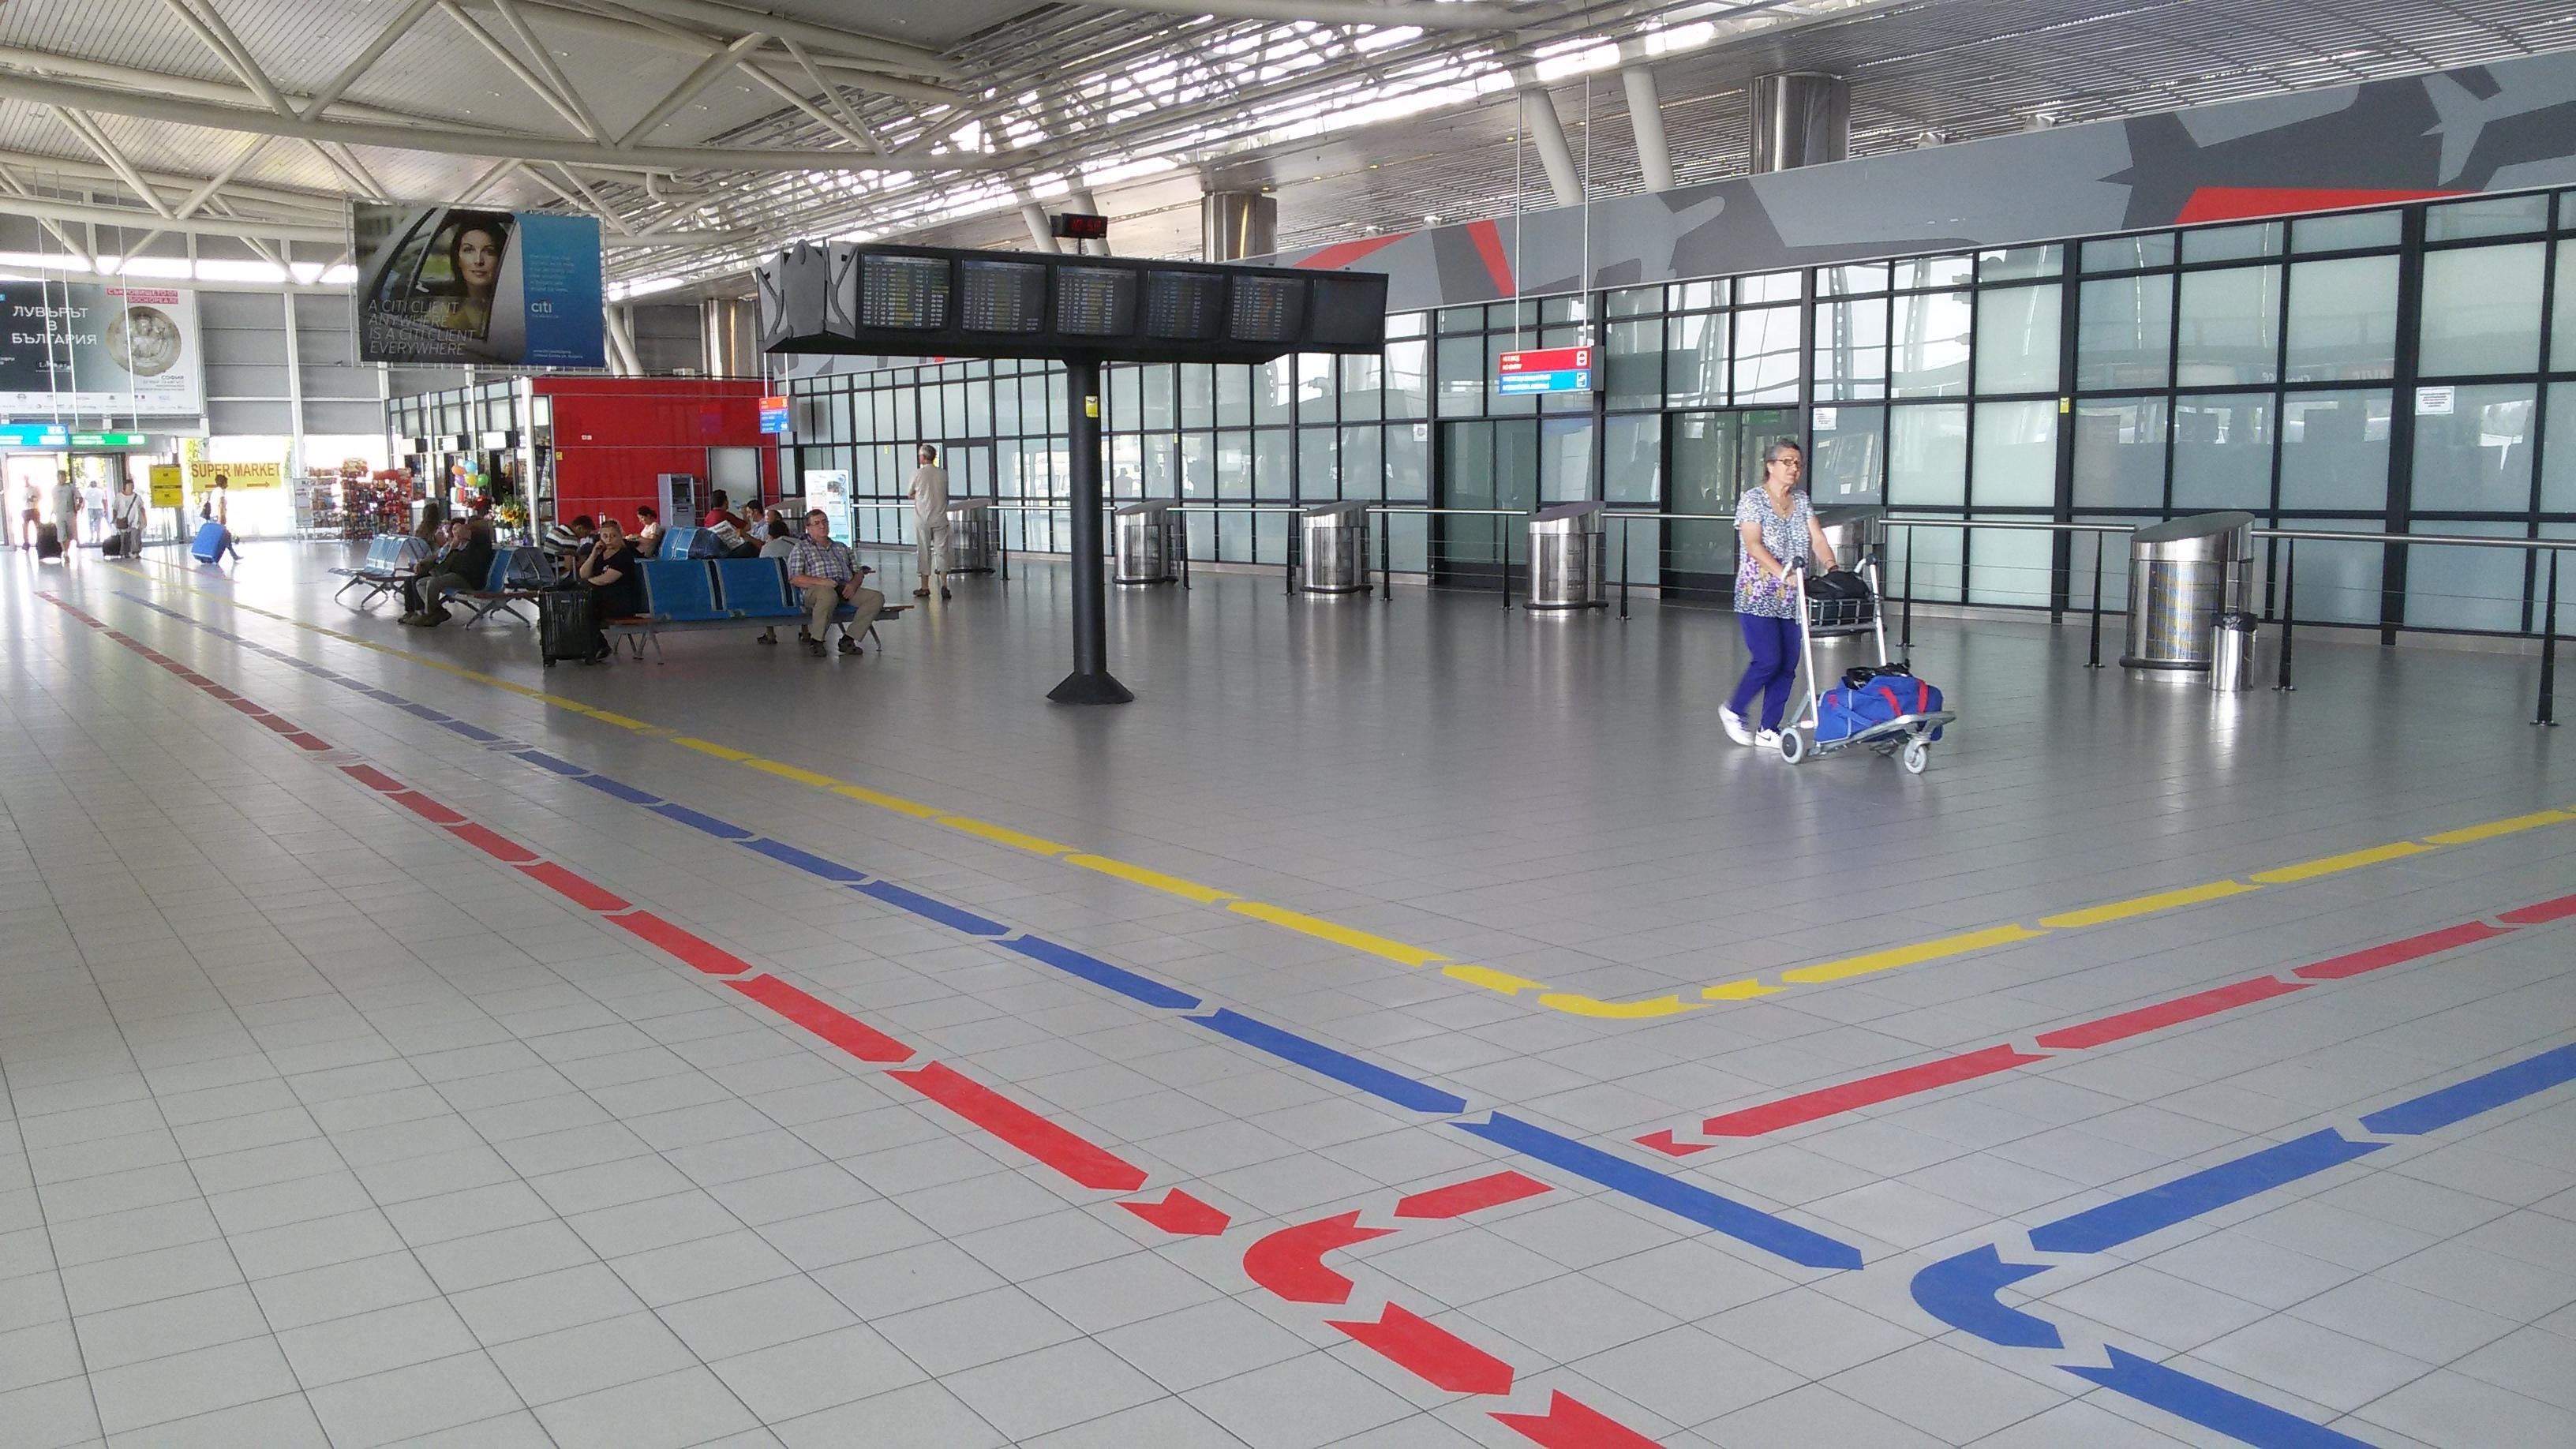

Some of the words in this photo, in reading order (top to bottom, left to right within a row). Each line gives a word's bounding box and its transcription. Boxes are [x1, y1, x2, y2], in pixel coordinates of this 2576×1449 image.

[368, 299, 378, 312] A
[381, 299, 406, 313] CITI
[411, 300, 459, 314] CLIENT
[531, 301, 552, 313] citi
[368, 313, 449, 328] ANYWHERE
[369, 328, 381, 340] IS
[386, 328, 395, 340] A
[399, 328, 424, 341] CITI
[428, 329, 477, 343] CLIENT
[370, 341, 467, 356] EVERYWHERE
[191, 462, 230, 478] SUPER
[234, 462, 281, 477] MARKET
